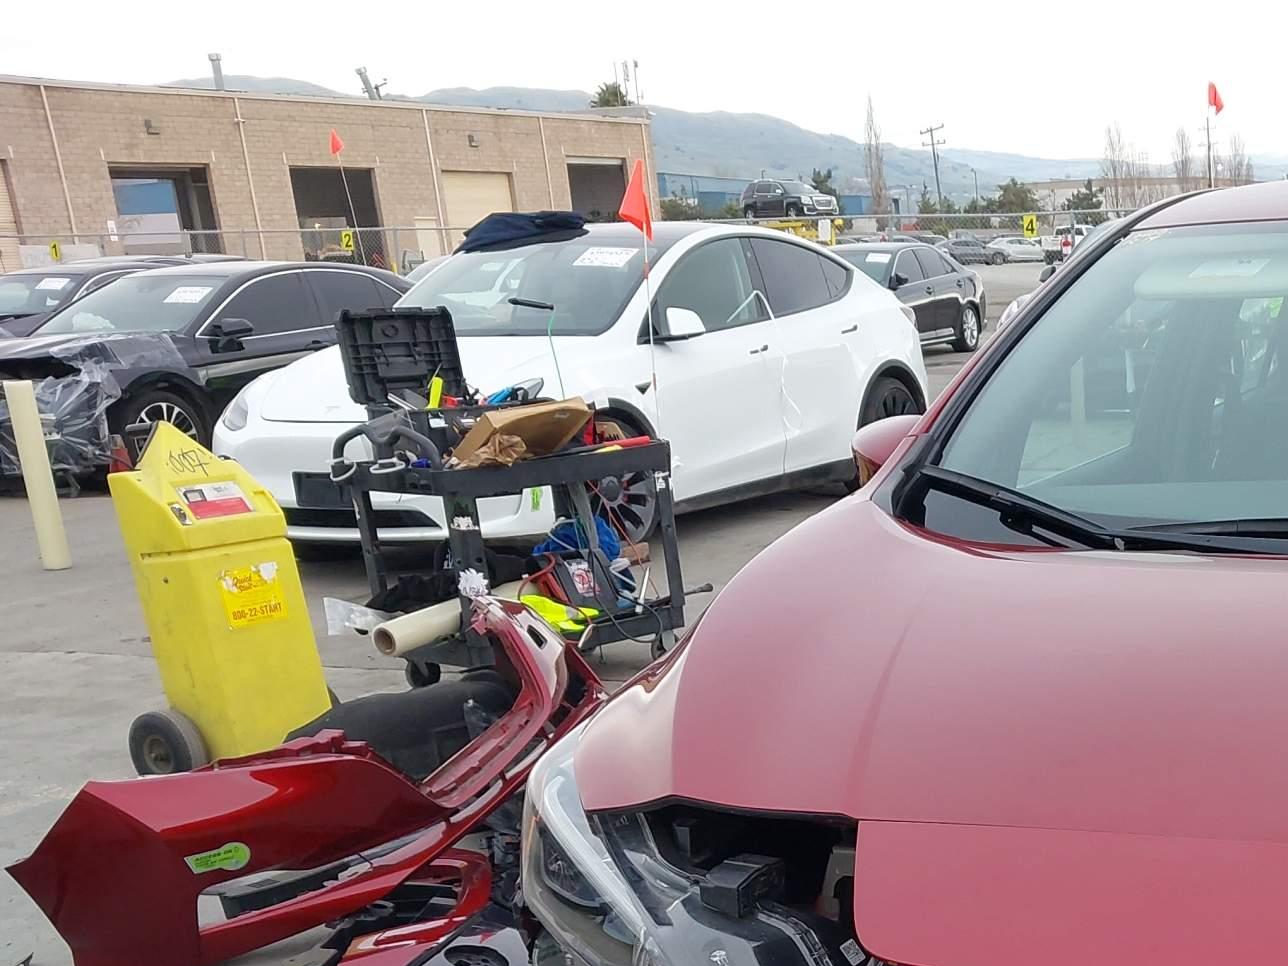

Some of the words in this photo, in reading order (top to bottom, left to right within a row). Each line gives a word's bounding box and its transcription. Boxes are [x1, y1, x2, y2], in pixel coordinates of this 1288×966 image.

[1025, 218, 1035, 235] 4
[343, 233, 352, 248] 2
[51, 243, 58, 258] 1
